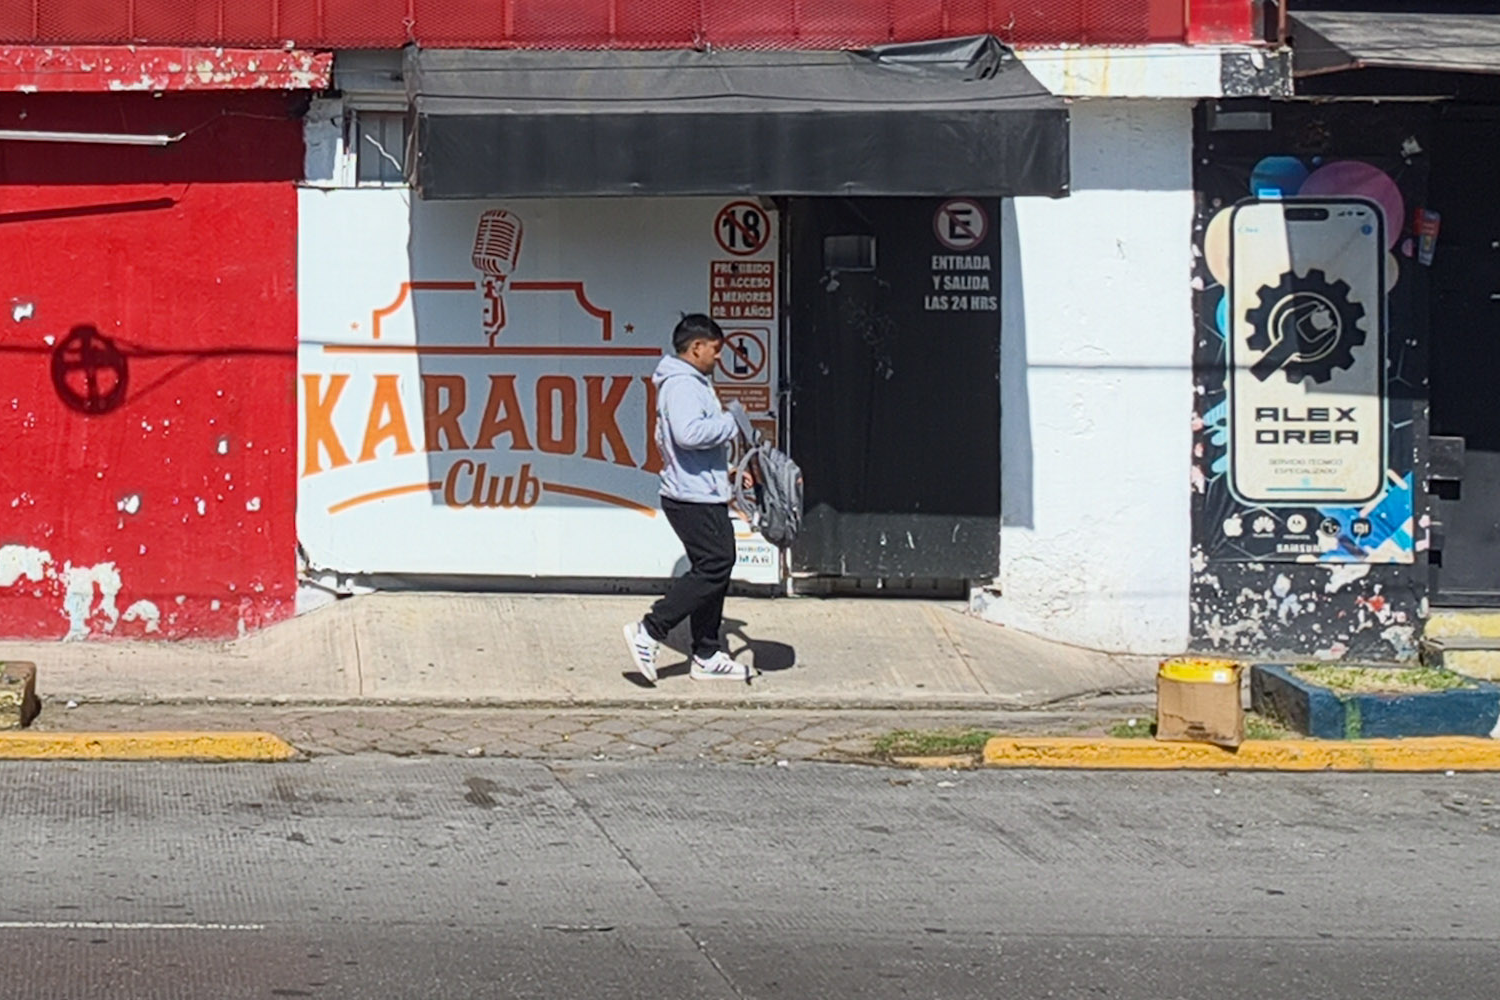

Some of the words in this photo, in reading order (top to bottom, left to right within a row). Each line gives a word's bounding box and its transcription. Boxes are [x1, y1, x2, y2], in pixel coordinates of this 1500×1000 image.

[722, 209, 760, 248] 18
[931, 255, 991, 270] ENTRADA
[714, 277, 725, 288] EL
[730, 277, 771, 288] ACCESO
[932, 275, 941, 290] Y
[943, 275, 990, 290] SALIDA
[712, 291, 720, 302] A
[722, 291, 772, 302] MENORES
[924, 295, 949, 310] LAS
[951, 295, 968, 310] 24
[970, 295, 998, 310] HRS
[712, 305, 726, 317] DE
[730, 305, 741, 317] 18
[743, 303, 772, 317] AÑOS
[1255, 407, 1357, 422] ALEX
[443, 459, 541, 510] Club
